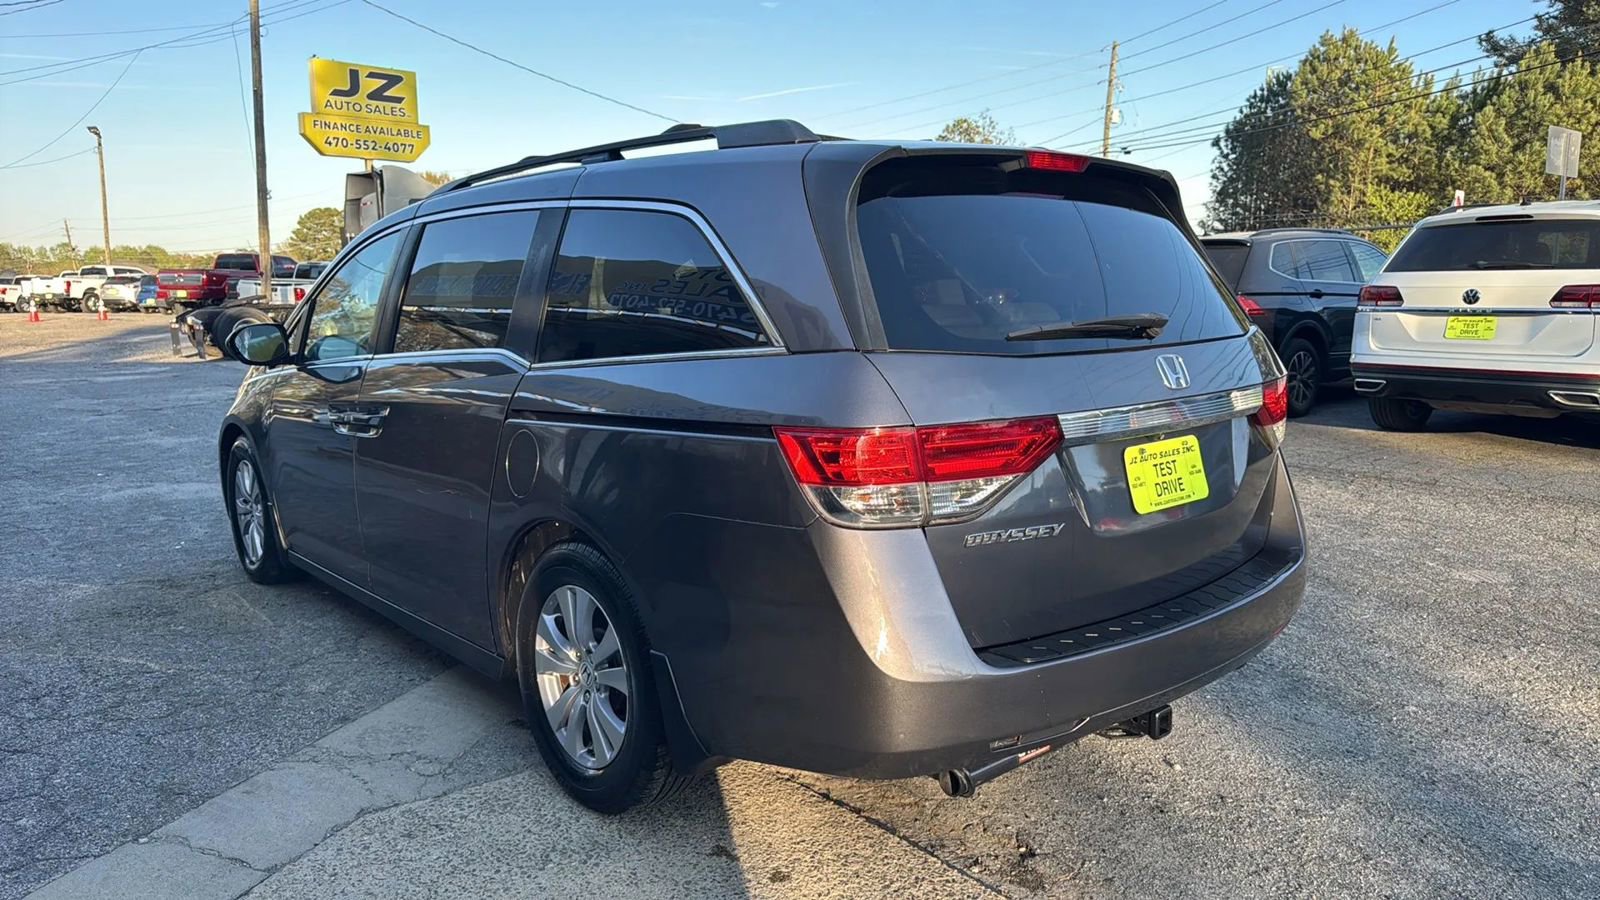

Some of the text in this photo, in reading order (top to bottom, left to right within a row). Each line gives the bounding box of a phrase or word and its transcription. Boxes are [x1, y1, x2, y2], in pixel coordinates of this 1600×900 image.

[329, 68, 406, 104] JZ
[324, 99, 407, 118] AUTO SALES
[313, 119, 423, 139] FINANCE AVAILABLE
[324, 136, 415, 154] 470-552-4077
[1140, 453, 1158, 463] AUTO
[1160, 447, 1181, 459] SALES
[1152, 460, 1178, 478] TEST
[1154, 477, 1186, 497] DRIVE
[963, 522, 1066, 548] ODYSSEY
